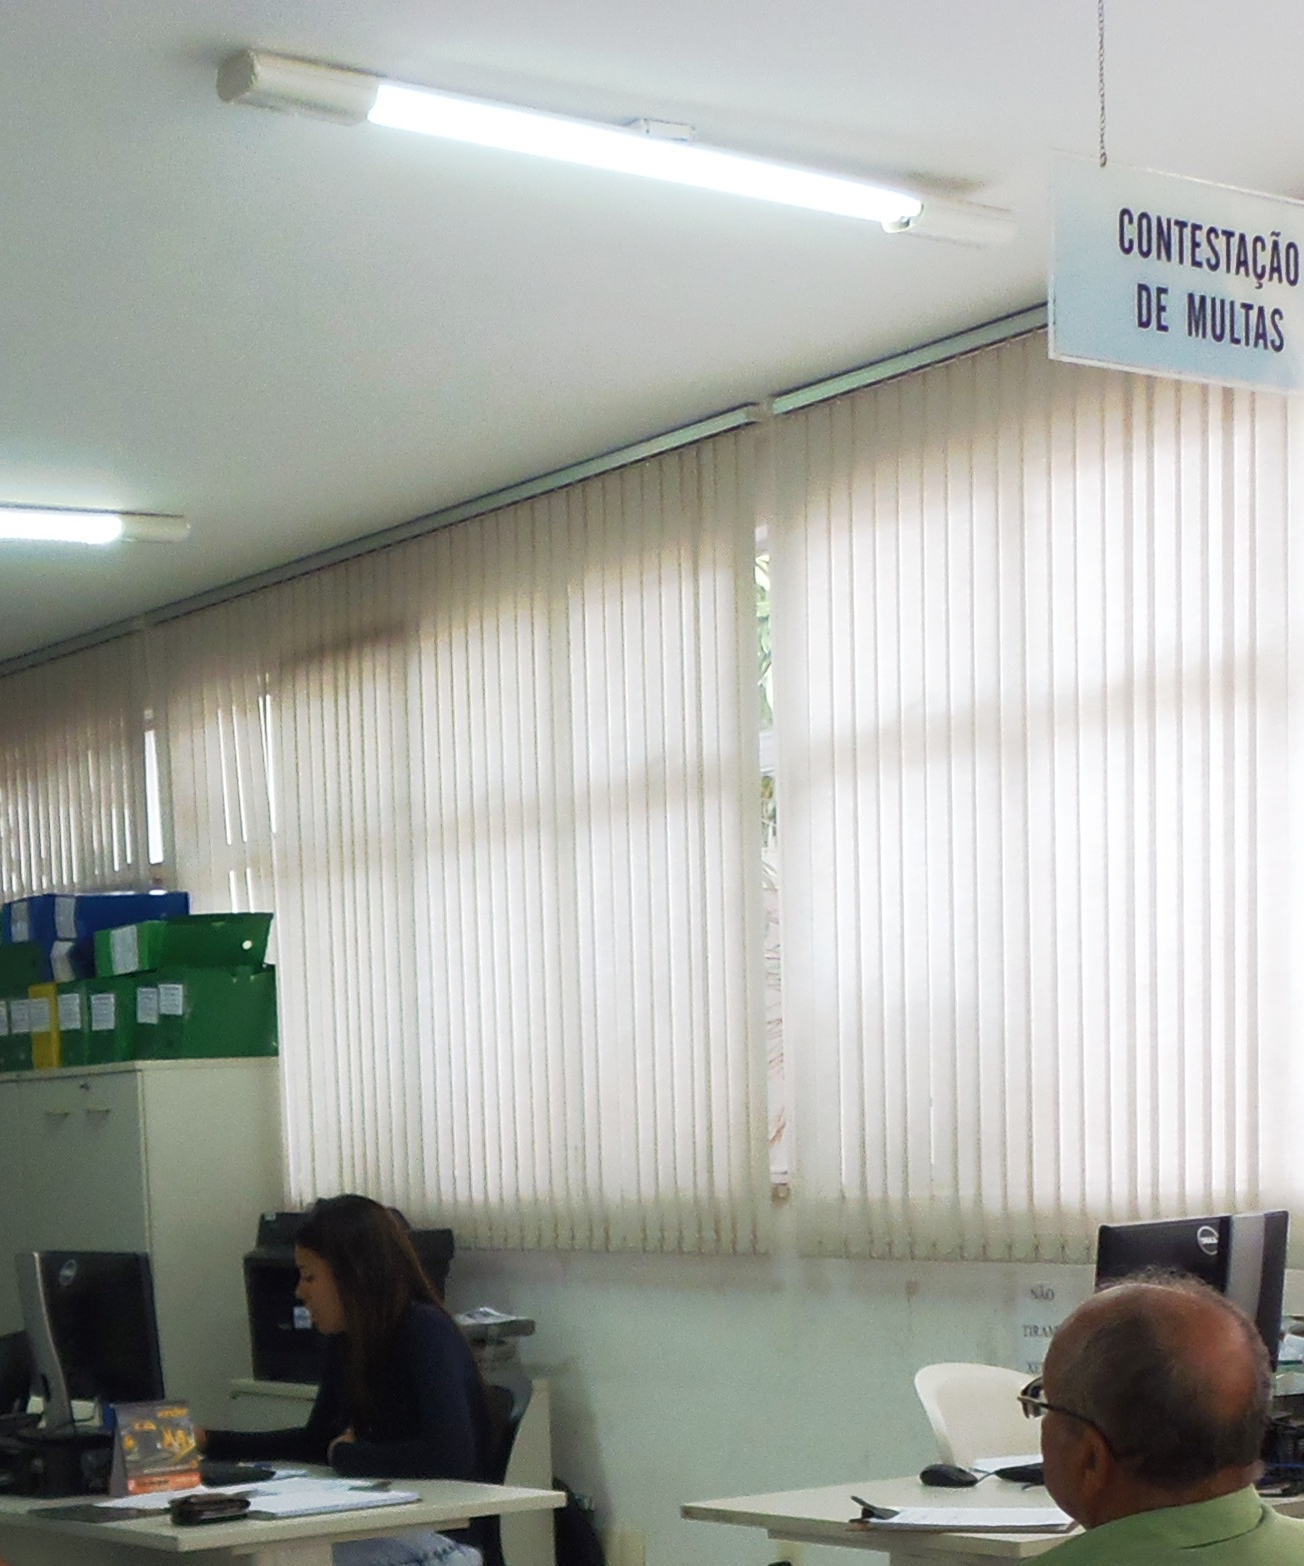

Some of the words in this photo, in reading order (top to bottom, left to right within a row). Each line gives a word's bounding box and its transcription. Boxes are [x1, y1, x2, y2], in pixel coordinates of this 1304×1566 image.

[1118, 207, 1300, 290] CONTESTAÇÃO
[1136, 283, 1169, 332] DE
[1186, 292, 1285, 353] MULTAS
[1030, 1285, 1055, 1302] NÃO
[1022, 1324, 1059, 1338] TIRAM
